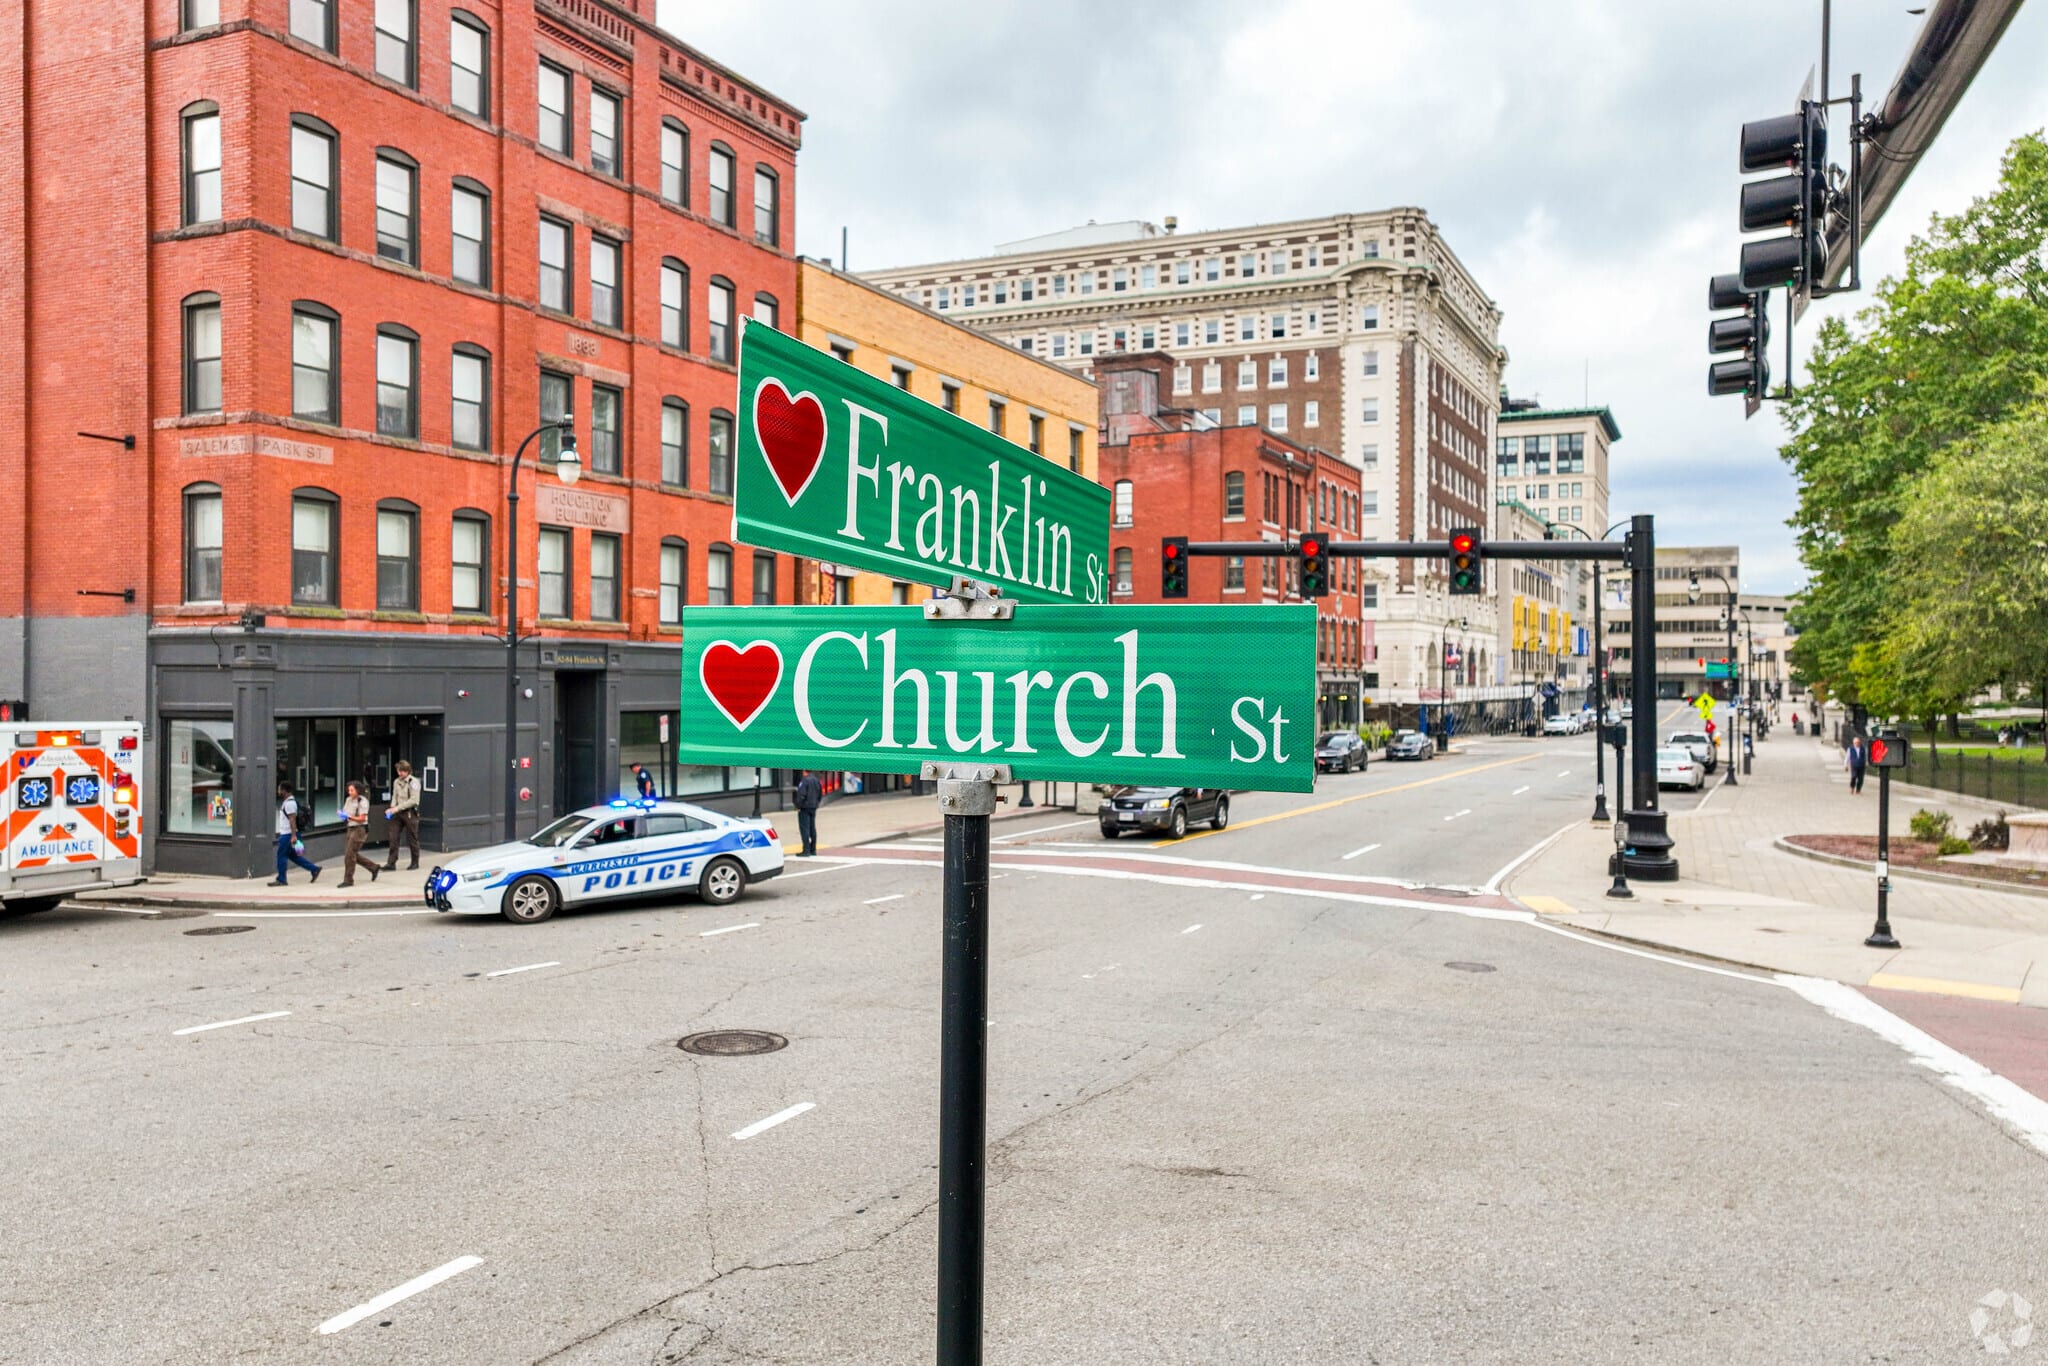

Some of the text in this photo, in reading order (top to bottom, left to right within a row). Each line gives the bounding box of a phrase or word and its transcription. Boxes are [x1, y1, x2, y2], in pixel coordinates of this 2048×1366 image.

[186, 437, 246, 456] SALEM ST
[262, 439, 325, 460] PARK ST
[551, 489, 611, 512] HOUGHTON
[837, 397, 1106, 605] Franklin St
[555, 507, 607, 528] BUILDING
[792, 627, 1291, 764] Church St
[21, 840, 94, 857] AMBULANCE
[568, 856, 640, 876] WORCESTER
[583, 861, 694, 894] POLICE
